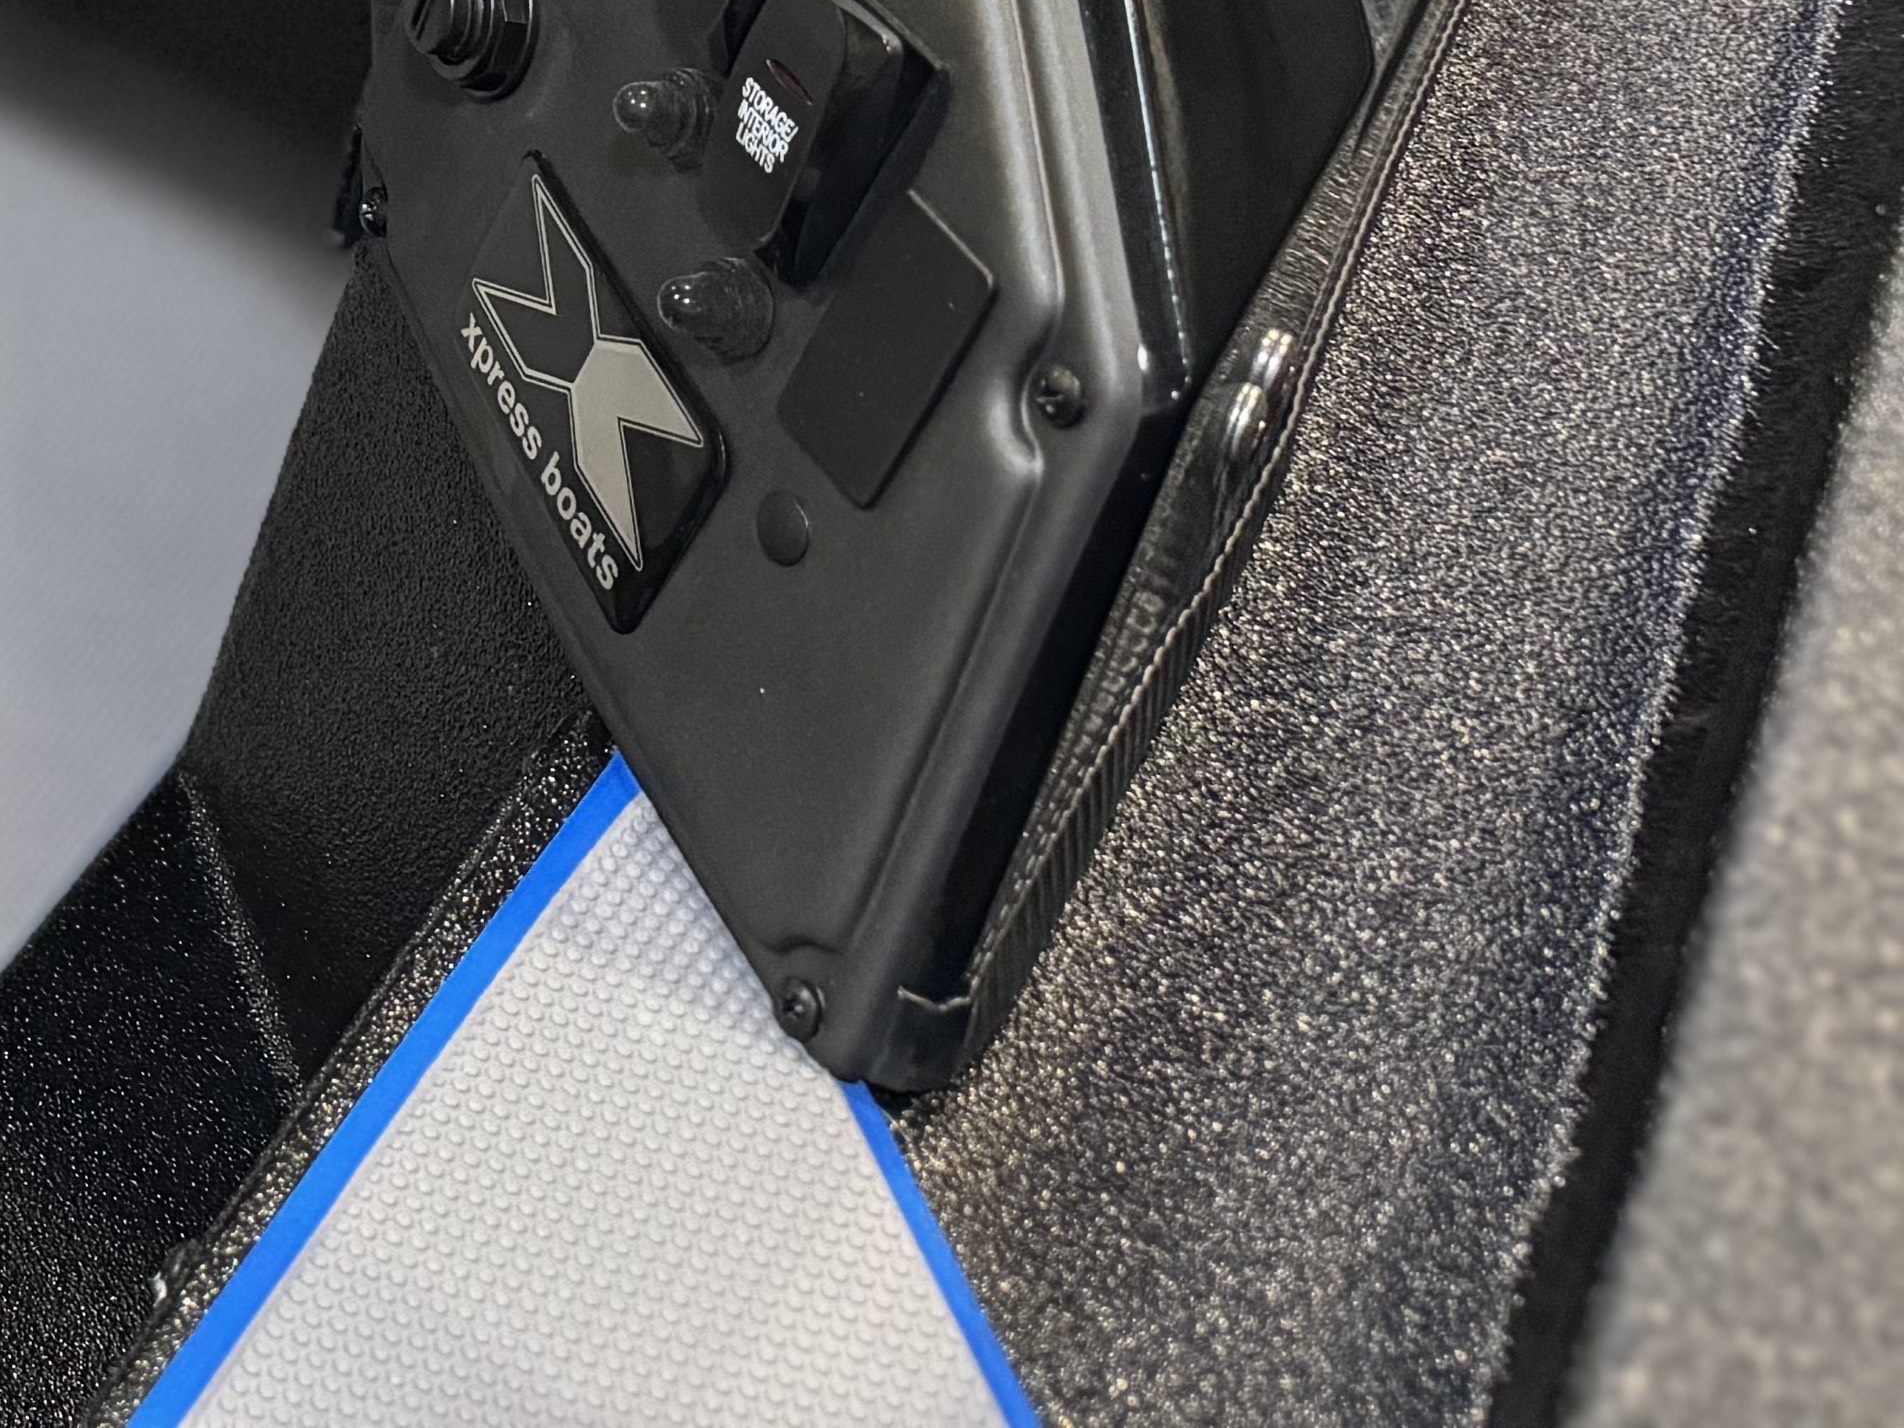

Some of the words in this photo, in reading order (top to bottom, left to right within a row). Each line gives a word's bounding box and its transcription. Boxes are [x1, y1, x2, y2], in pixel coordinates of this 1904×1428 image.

[735, 121, 775, 174] LIGHTS
[737, 98, 789, 163] INTERIOR
[459, 312, 542, 461] xpress
[540, 451, 619, 590] boats
